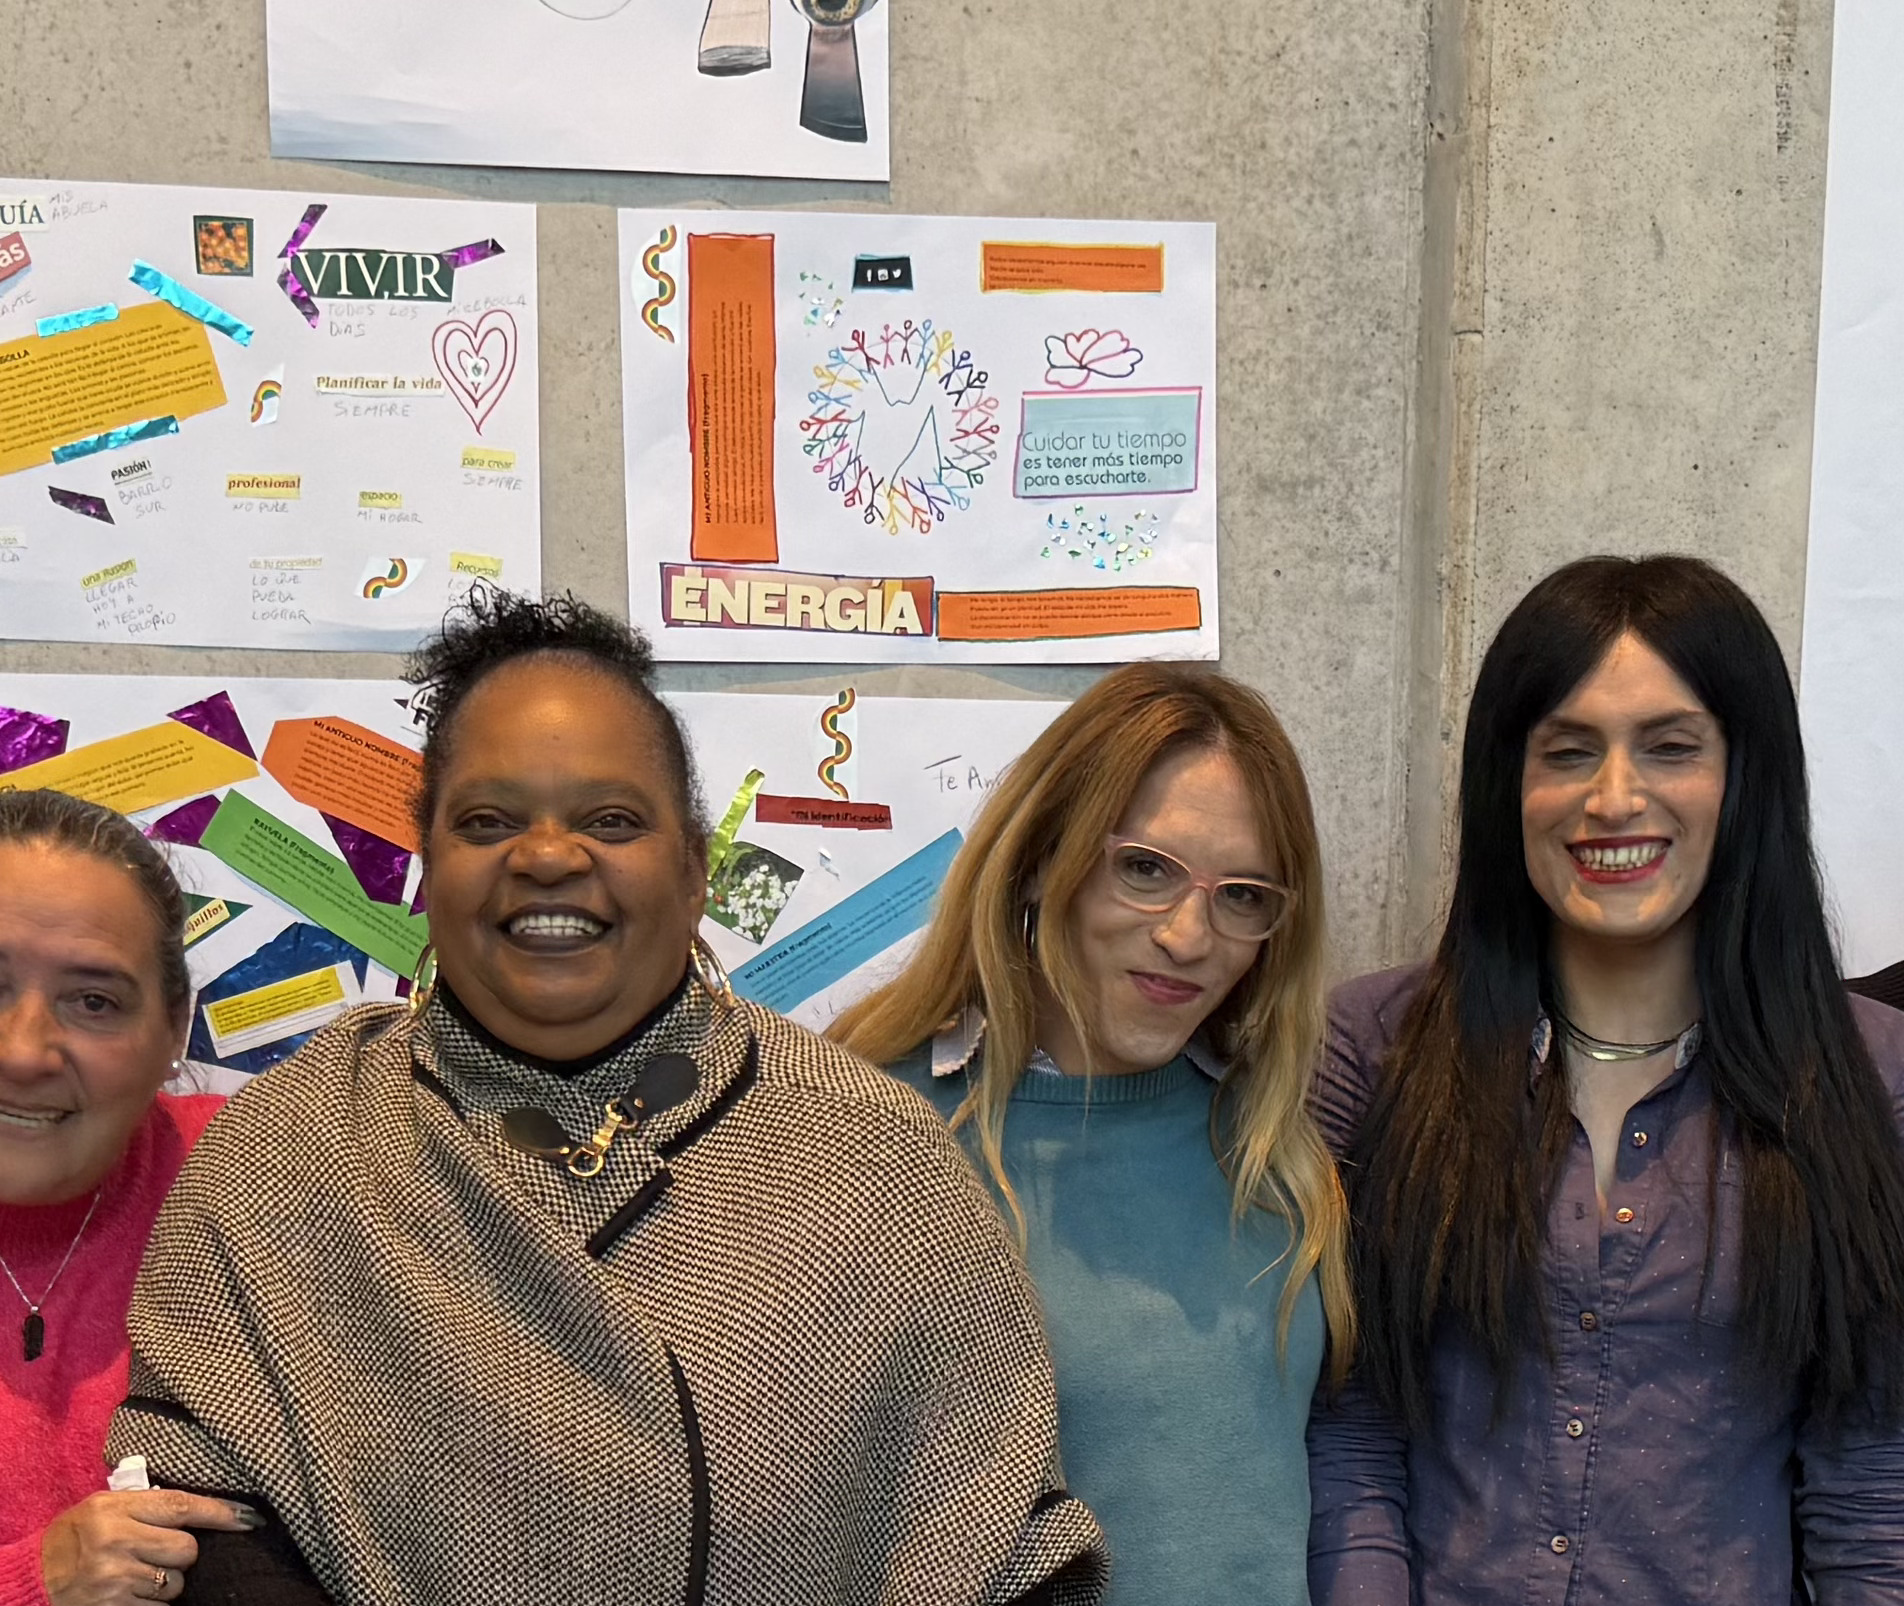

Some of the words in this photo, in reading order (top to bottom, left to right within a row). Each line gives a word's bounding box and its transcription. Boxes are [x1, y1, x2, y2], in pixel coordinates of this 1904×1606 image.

[297, 251, 450, 298] VIVIR
[316, 376, 388, 389] Planificar
[393, 376, 406, 389] la
[413, 377, 442, 390] vida
[1022, 431, 1086, 451] Cuidar
[1092, 433, 1110, 449] tu
[1117, 430, 1187, 451] tiempo
[1023, 458, 1041, 470] es
[1046, 455, 1087, 469] tener
[1093, 452, 1124, 467] más
[1129, 452, 1184, 468] tiempo
[227, 476, 301, 490] profesional
[1024, 474, 1060, 491] para
[1064, 469, 1152, 486] escucharte.
[671, 574, 924, 635] ENERGÍA
